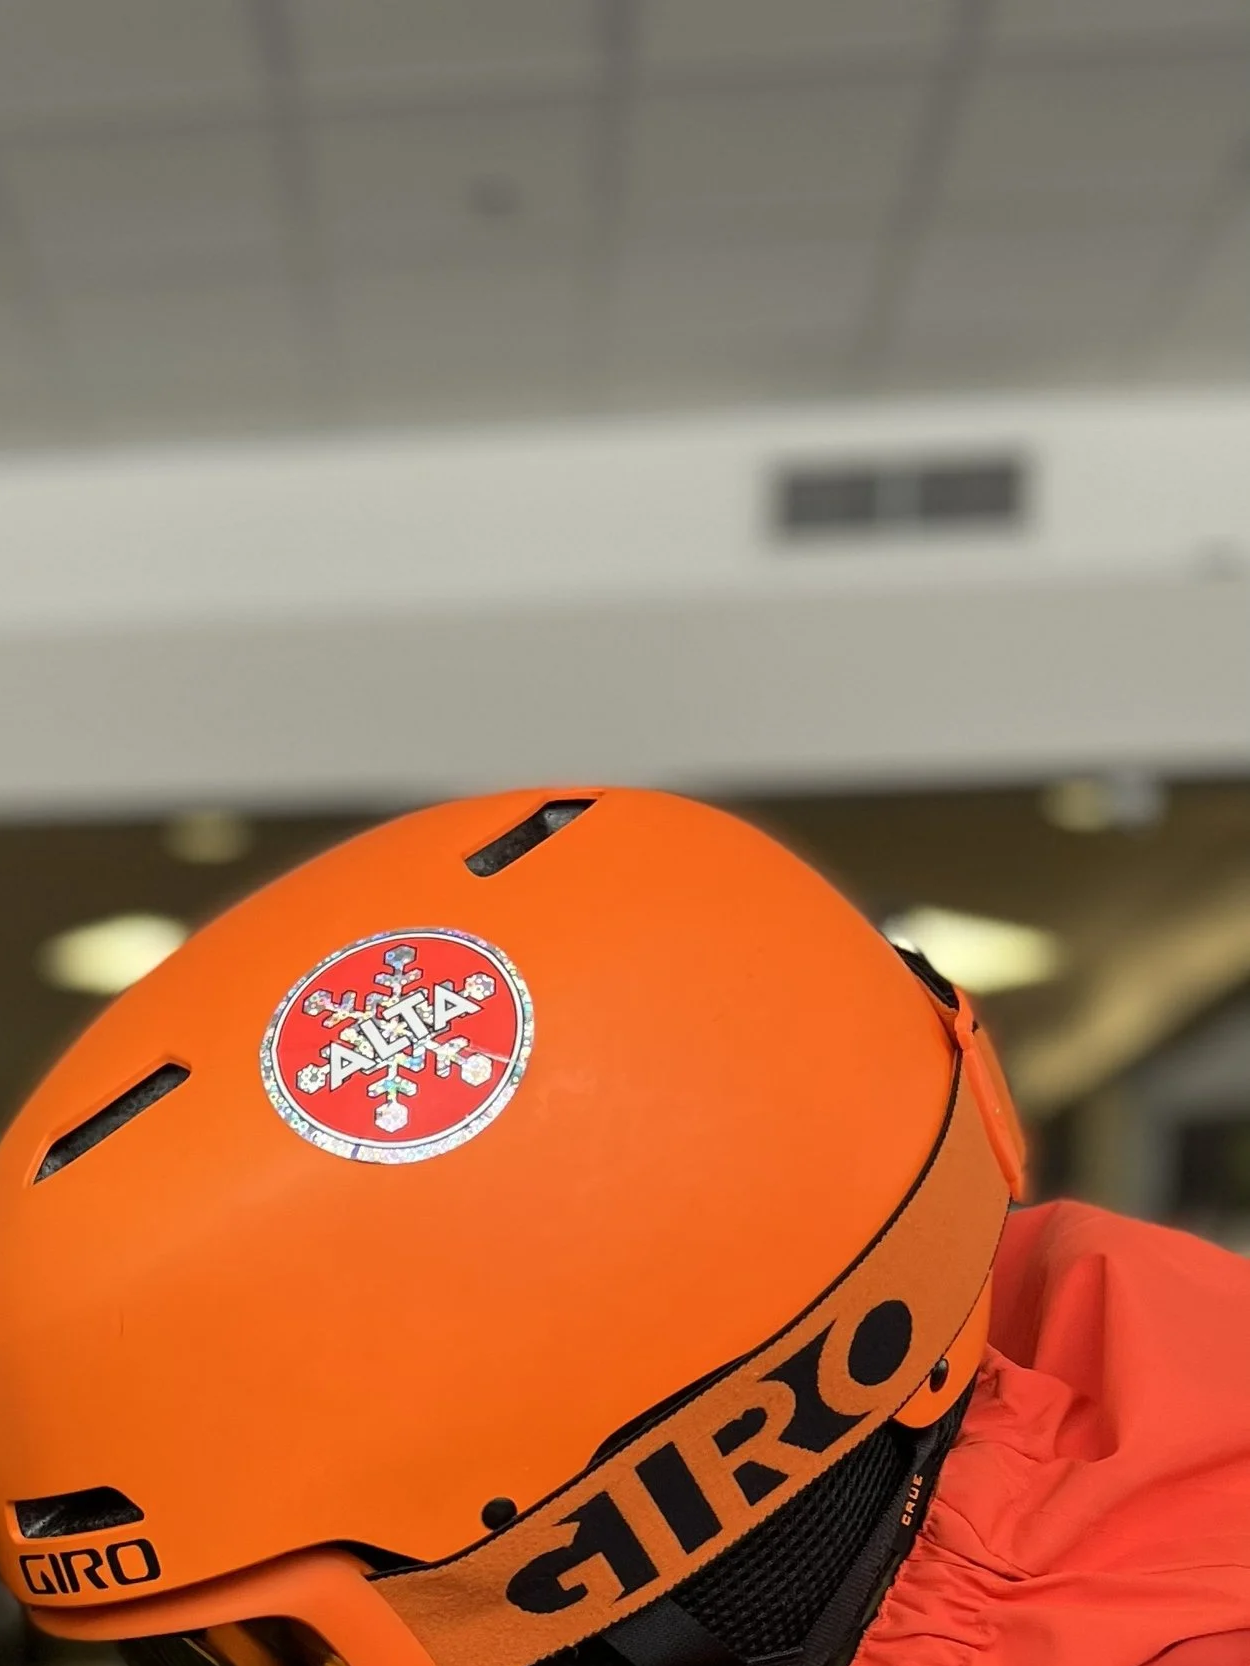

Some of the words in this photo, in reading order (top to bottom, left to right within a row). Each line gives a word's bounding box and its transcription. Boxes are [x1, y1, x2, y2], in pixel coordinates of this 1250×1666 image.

[329, 983, 485, 1092] ALTA
[506, 1299, 913, 1614] GIRO
[901, 1473, 923, 1526] CRUE
[18, 1538, 161, 1595] GIRO
